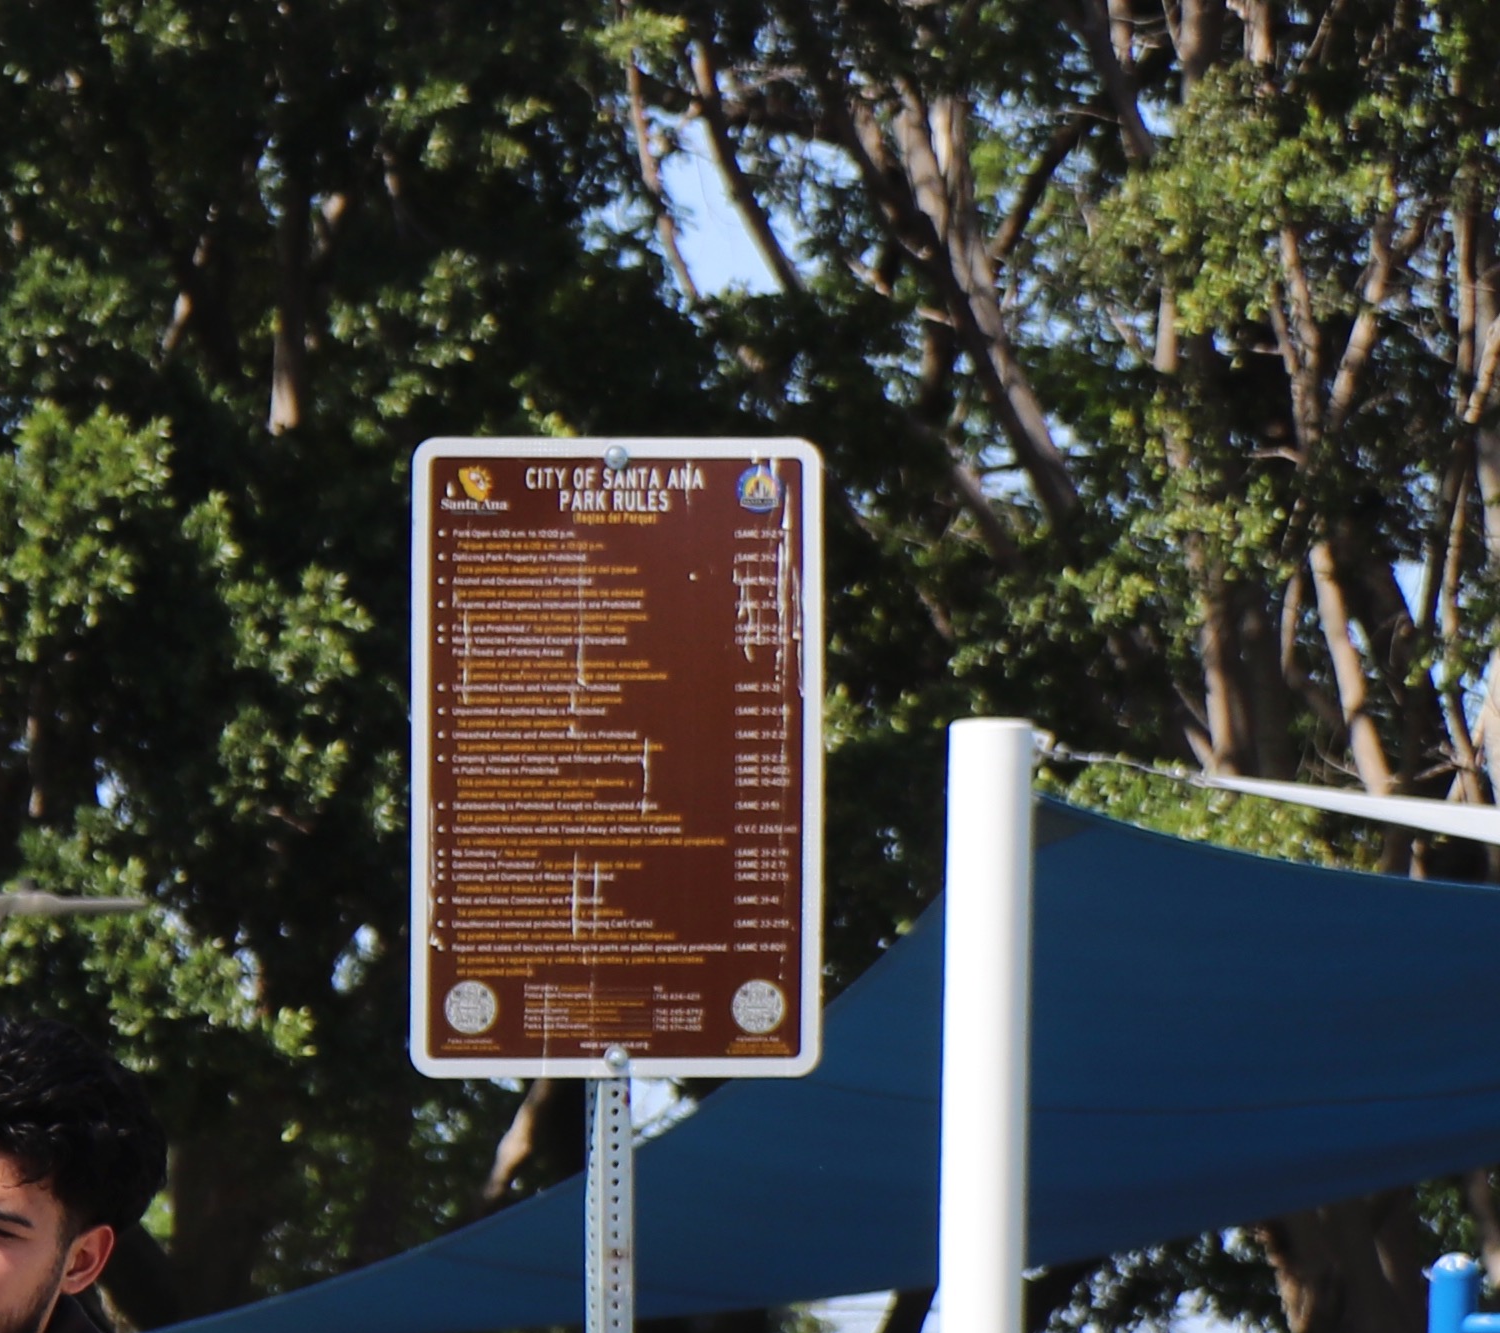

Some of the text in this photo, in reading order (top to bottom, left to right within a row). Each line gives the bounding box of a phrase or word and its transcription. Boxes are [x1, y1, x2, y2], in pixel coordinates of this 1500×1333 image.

[525, 466, 704, 490] CITY OF SANTA ANA
[440, 498, 509, 510] Santa Ana
[559, 491, 670, 512] PARK RULES
